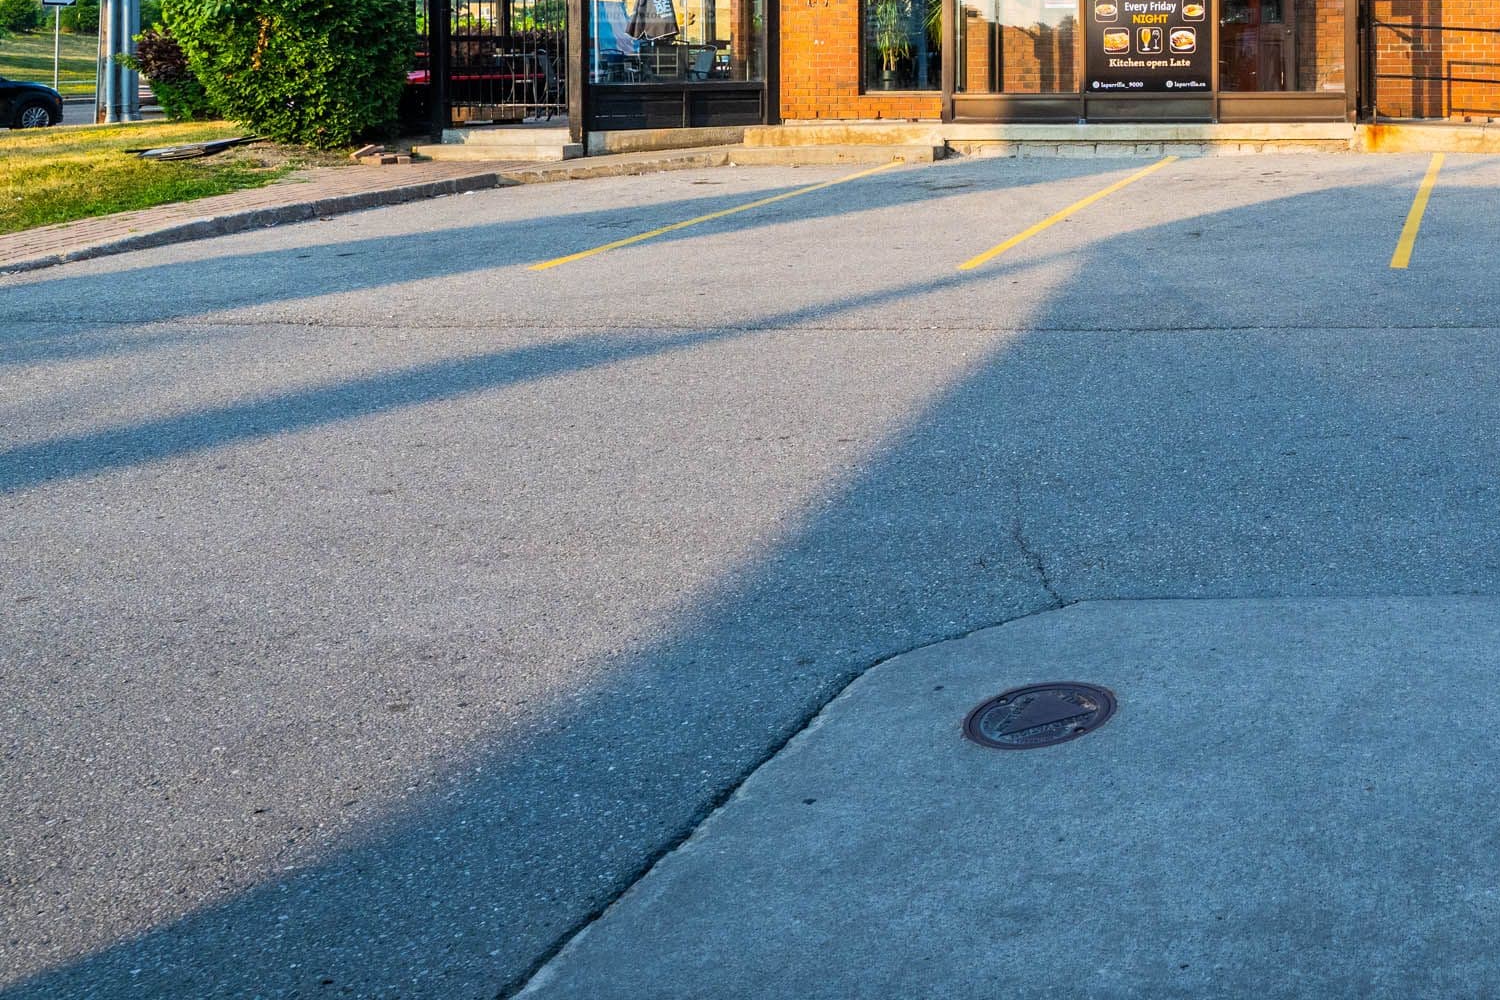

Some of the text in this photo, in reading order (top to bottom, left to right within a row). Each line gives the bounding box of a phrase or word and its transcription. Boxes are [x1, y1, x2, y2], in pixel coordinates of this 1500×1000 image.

[1124, 1, 1177, 13] Every Friday
[1132, 14, 1168, 24] NIGHT
[1109, 58, 1191, 69] Kitchen open Late
